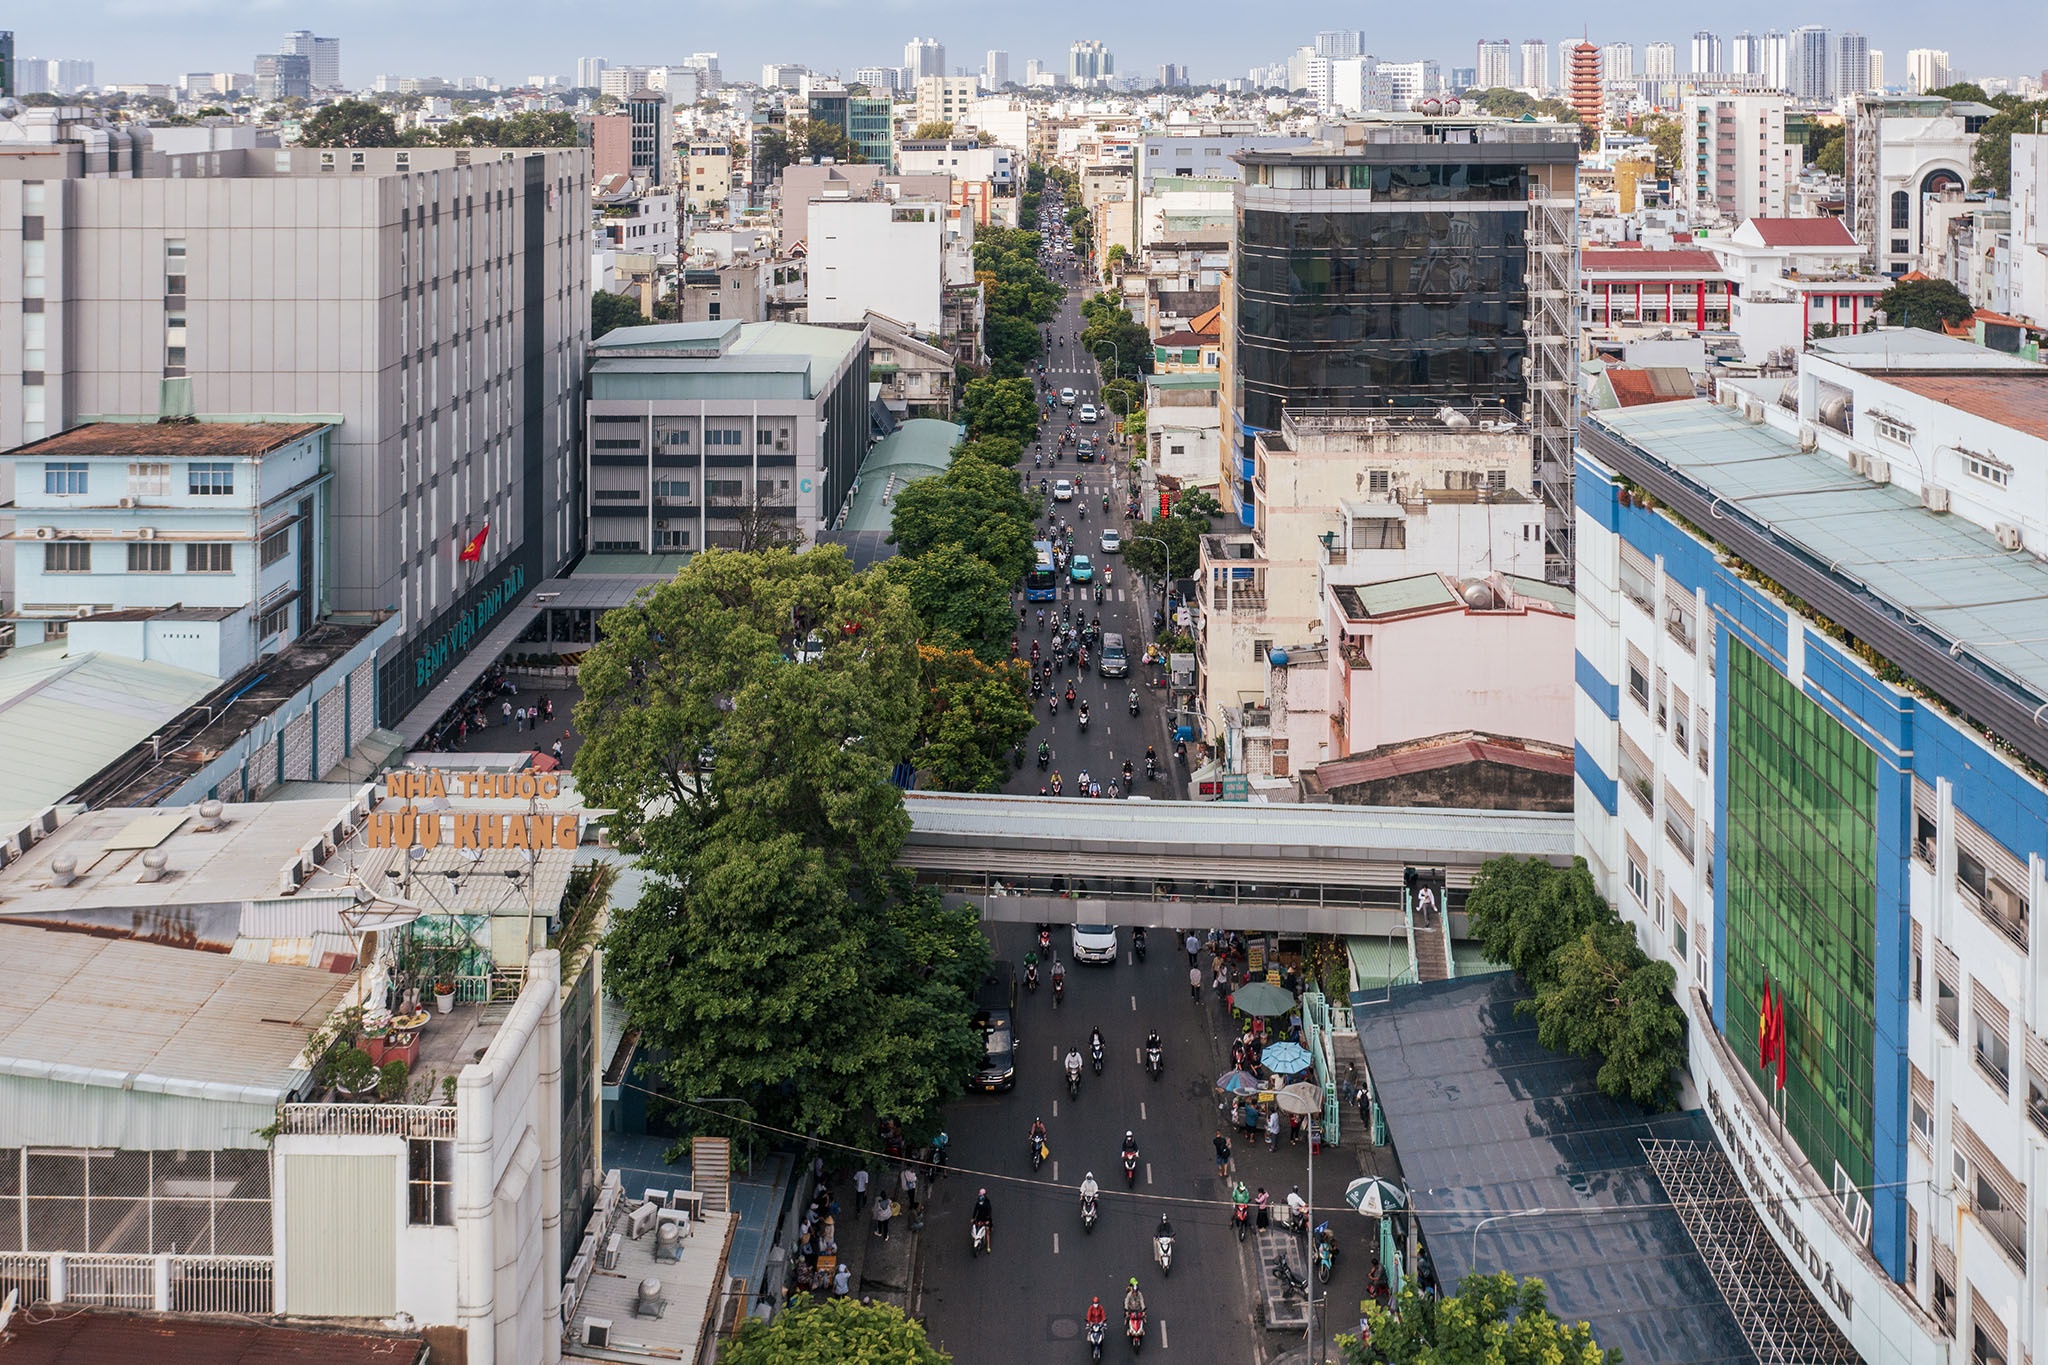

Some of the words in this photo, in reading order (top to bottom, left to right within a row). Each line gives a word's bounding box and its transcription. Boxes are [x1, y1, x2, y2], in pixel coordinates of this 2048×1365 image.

[800, 478, 812, 493] C
[416, 634, 448, 687] BỆNH
[448, 609, 475, 652] VIỆN
[477, 585, 502, 629] BÌNH
[504, 564, 524, 603] DÂN
[387, 768, 447, 799] NHÀ
[456, 765, 558, 800] THUỐC
[368, 805, 440, 849] HỮU
[454, 815, 578, 850] KHANG
[1707, 1079, 1737, 1153] BỆNH
[1735, 1136, 1767, 1207] VIỆN
[1765, 1186, 1808, 1265] BÌNH
[1808, 1244, 1854, 1321] DÂN
